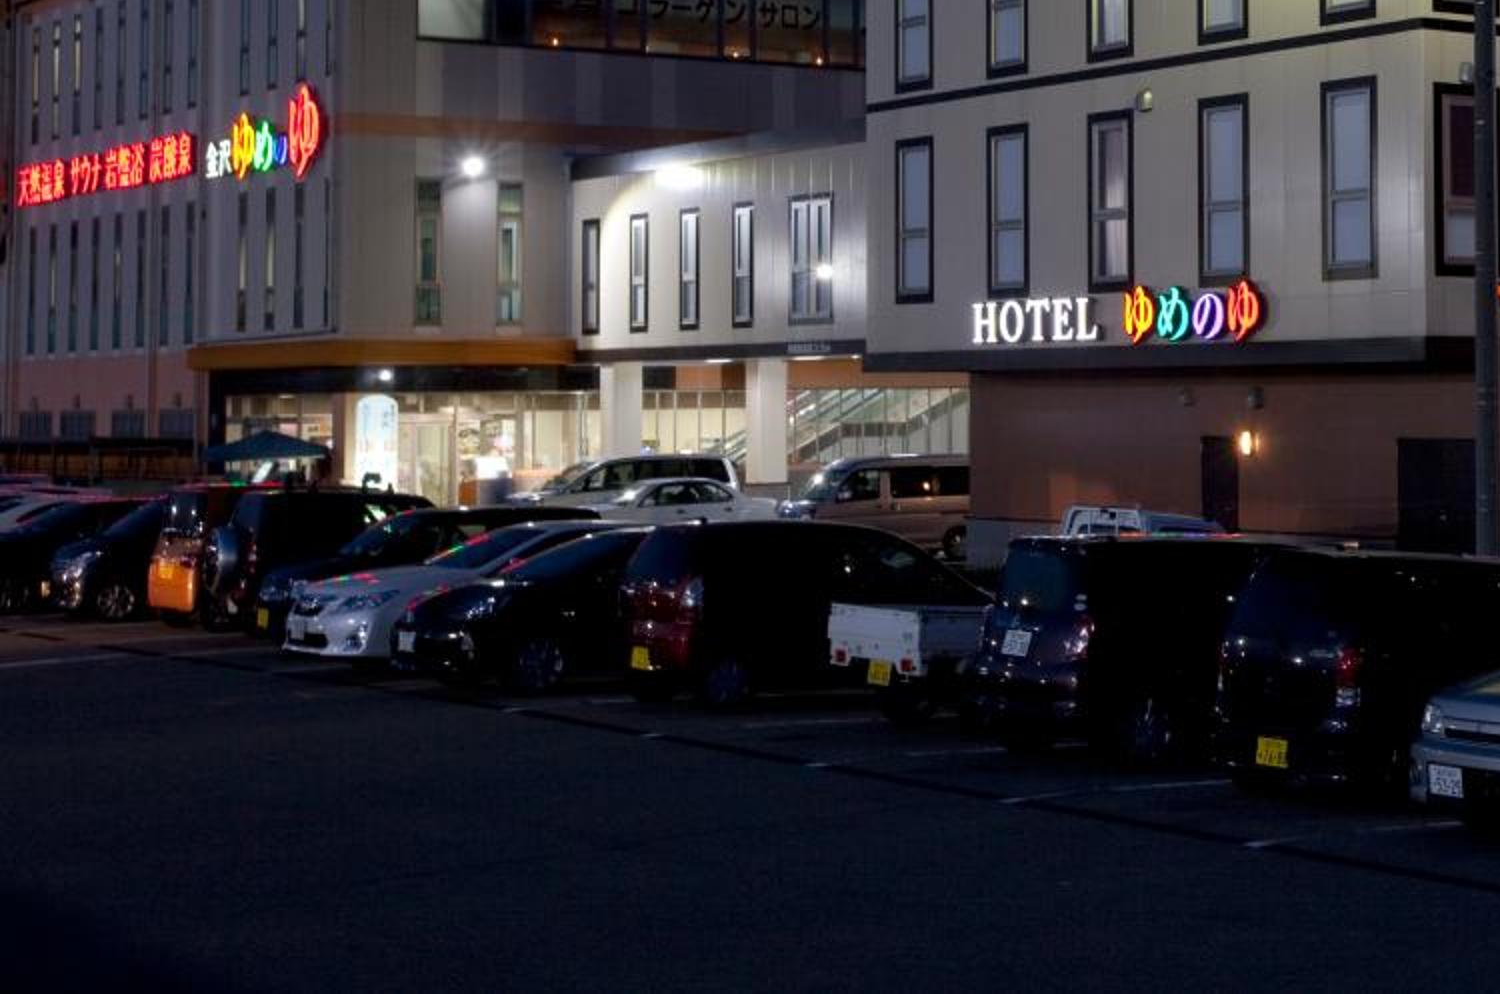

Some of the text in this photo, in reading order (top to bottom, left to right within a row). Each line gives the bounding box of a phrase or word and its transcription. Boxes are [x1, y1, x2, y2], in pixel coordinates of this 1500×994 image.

[70, 153, 100, 194] サウナ
[972, 280, 1260, 344] HOTEL ゆめのゆ
